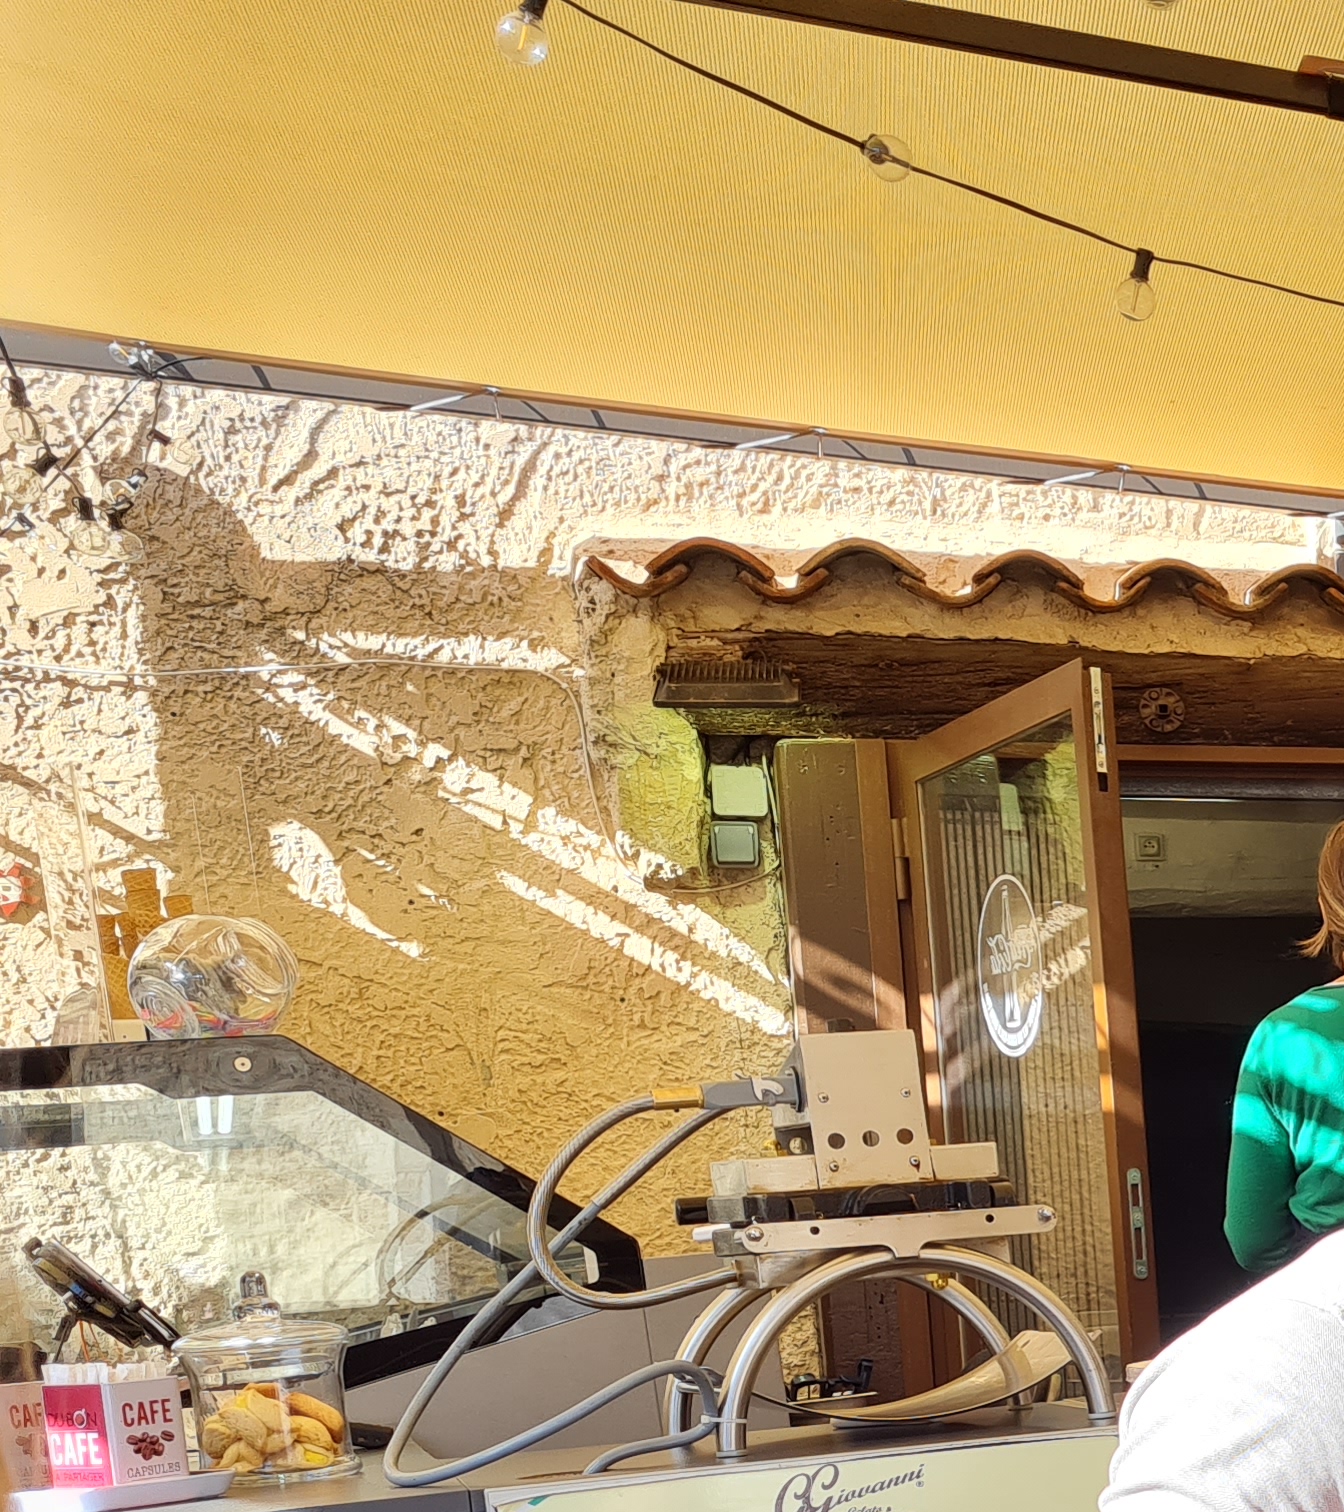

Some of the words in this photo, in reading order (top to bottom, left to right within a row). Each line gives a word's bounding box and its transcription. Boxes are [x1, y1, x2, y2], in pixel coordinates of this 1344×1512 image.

[10, 1402, 43, 1429] CAF
[122, 1398, 174, 1428] CAFE
[51, 1432, 103, 1466] CAFE
[127, 1461, 182, 1479] CAPSULES
